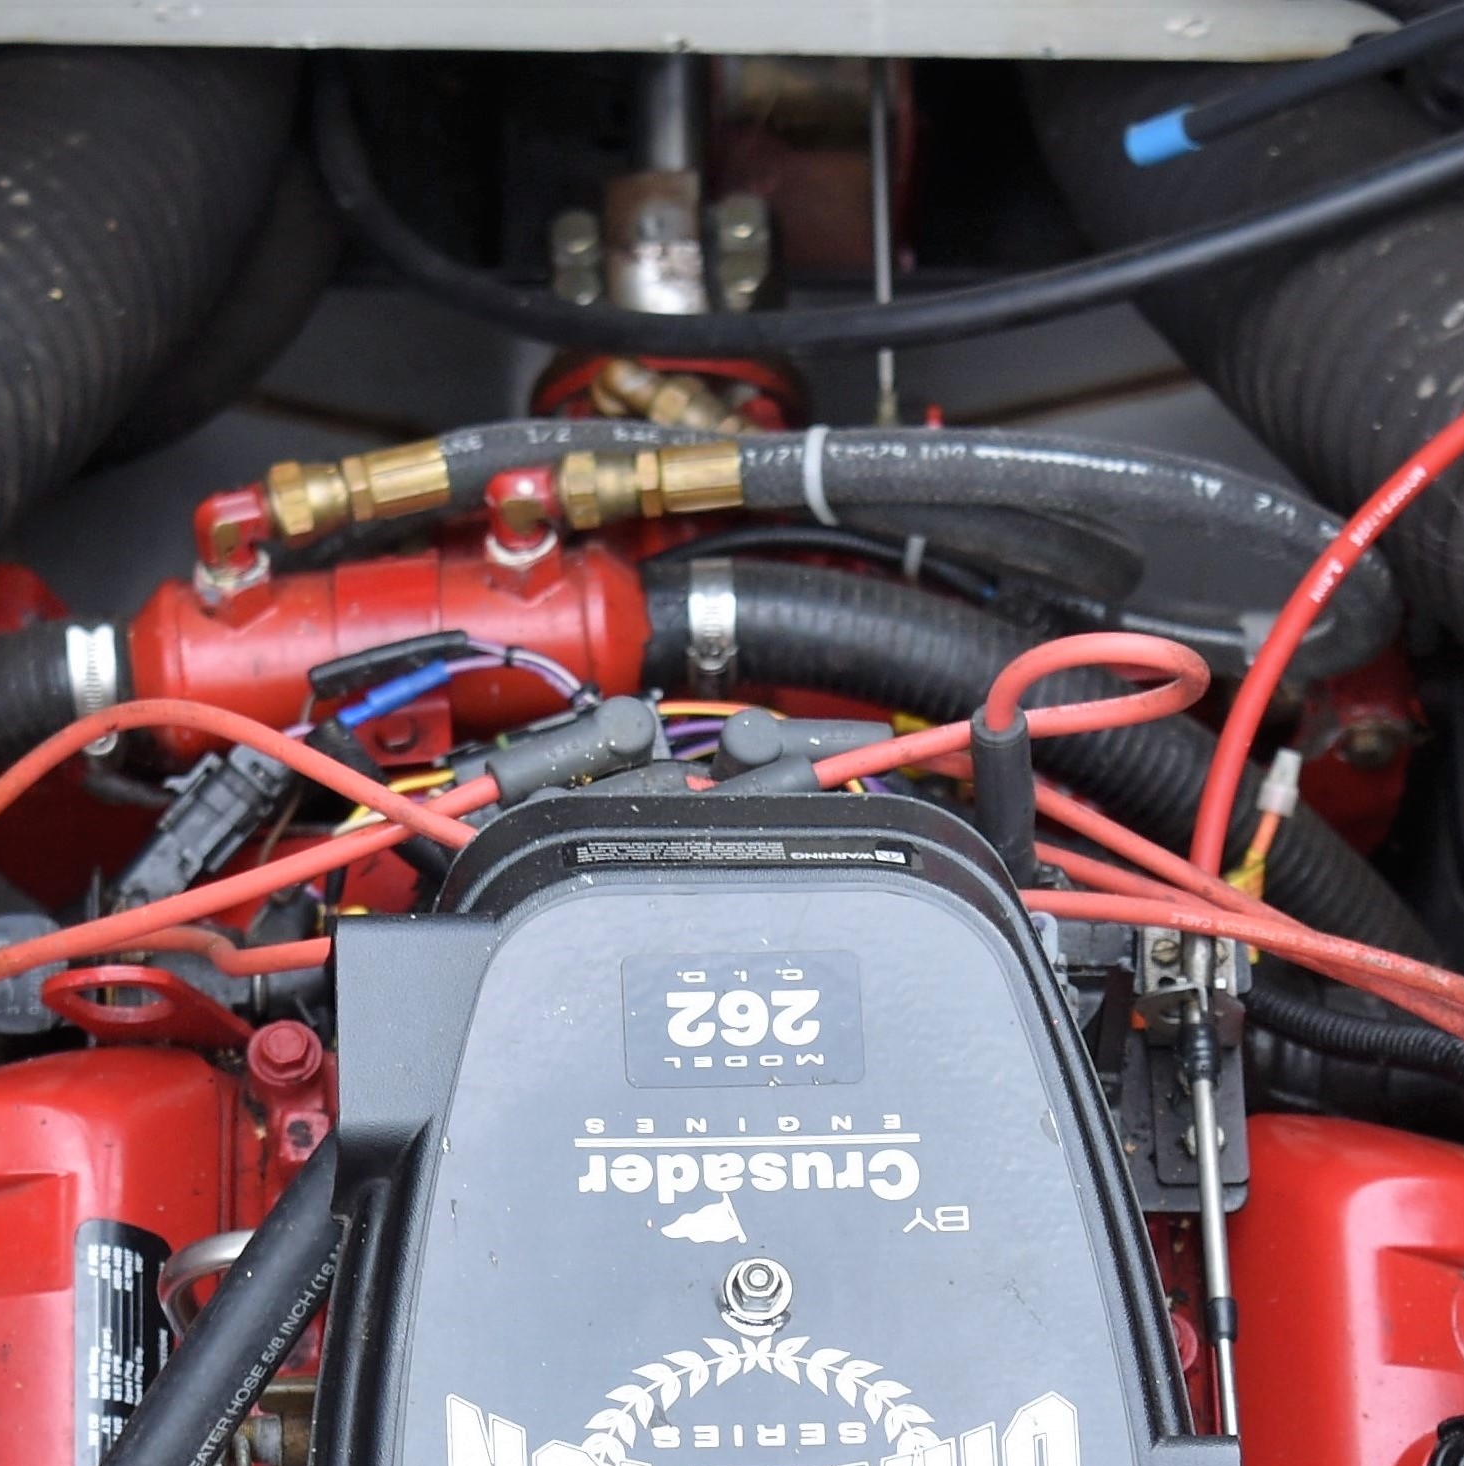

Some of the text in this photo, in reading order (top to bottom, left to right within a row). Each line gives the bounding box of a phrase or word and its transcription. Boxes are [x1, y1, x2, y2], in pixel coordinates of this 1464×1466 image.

[790, 849, 876, 862] WARNING
[666, 989, 821, 1048] 262
[663, 1053, 824, 1069] MODEL
[584, 1113, 902, 1135] ENGINES
[577, 1148, 921, 1204] Crusader
[902, 1205, 970, 1234] BY
[226, 1363, 269, 1417] HOSE
[261, 1335, 287, 1366] 5/8
[278, 1289, 318, 1339] INCH
[651, 1420, 868, 1449] SERIES
